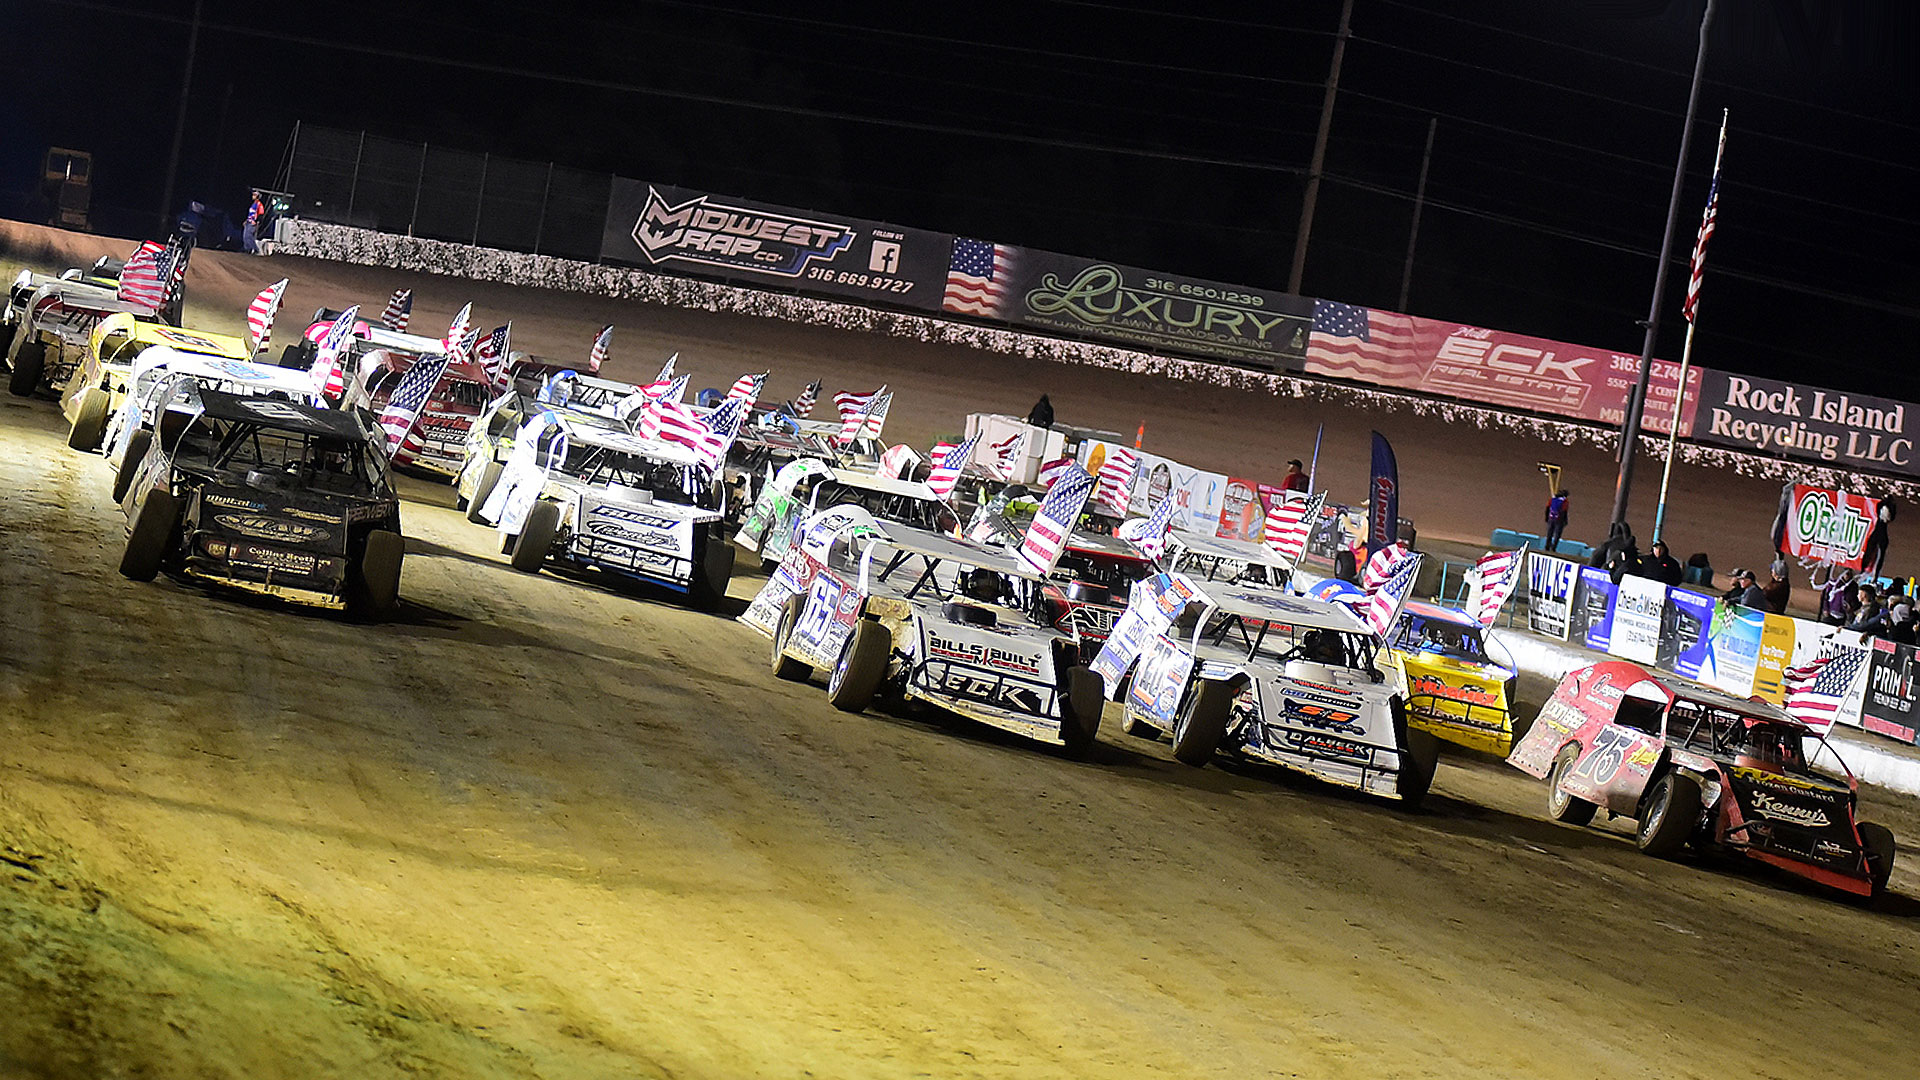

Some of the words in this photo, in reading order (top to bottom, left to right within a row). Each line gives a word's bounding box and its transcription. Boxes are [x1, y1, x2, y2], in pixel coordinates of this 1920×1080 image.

[646, 200, 842, 249] MIDWEST
[807, 267, 914, 294] 316.669.9727
[1144, 278, 1265, 307] 316.650.1239
[1111, 315, 1153, 330] LAWN
[1166, 321, 1273, 350] LANDSCAPING
[1436, 335, 1596, 382] ECK
[1494, 373, 1582, 395] ESTATE
[1725, 376, 1802, 417] Rock
[1810, 391, 1904, 433] Island
[1709, 408, 1840, 461] Recycling
[1845, 431, 1913, 465] LLC
[1531, 555, 1572, 598] WILKS
[930, 636, 983, 656] BILLS
[990, 650, 1040, 668] BUILT
[946, 673, 1034, 712] ECK
[1751, 790, 1828, 822] Kenny's
